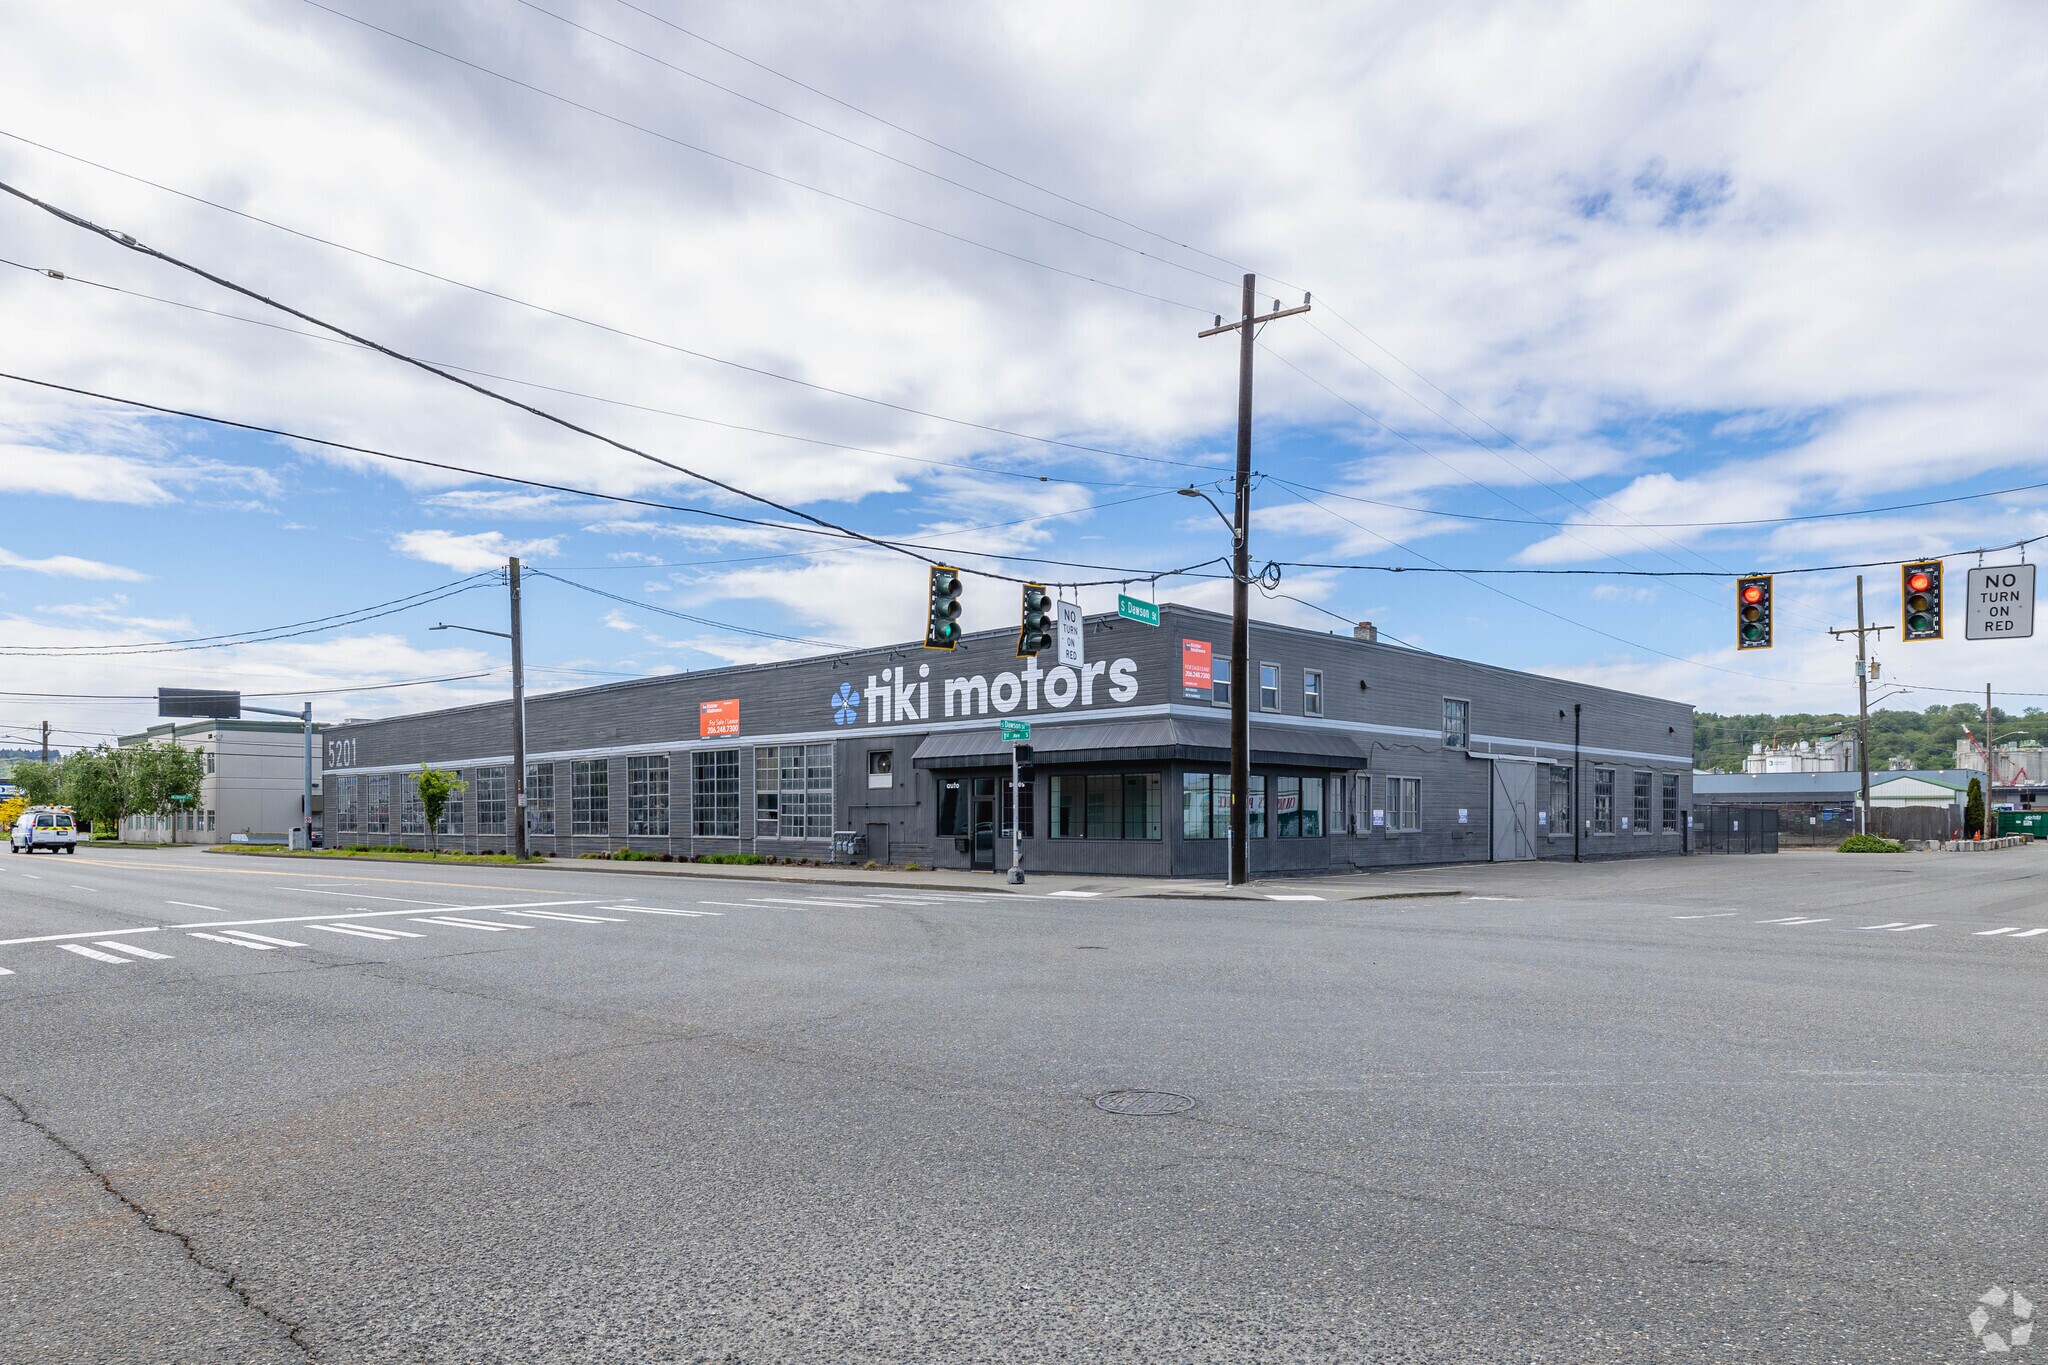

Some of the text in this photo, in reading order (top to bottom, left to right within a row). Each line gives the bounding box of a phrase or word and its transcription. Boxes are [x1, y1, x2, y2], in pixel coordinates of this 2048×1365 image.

[1986, 574, 2016, 588] NO
[1980, 591, 2020, 603] TURN
[1064, 609, 1076, 623] NO
[1120, 600, 1157, 621] S Dawson St
[1989, 606, 2009, 617] ON
[1063, 624, 1078, 635] TURN
[1985, 620, 2014, 631] RED
[1067, 637, 1076, 647] ON
[1065, 649, 1077, 661] RED
[864, 656, 1138, 724] tiki motors
[1005, 720, 1022, 730] Dawson
[328, 738, 356, 768] 5201
[946, 781, 960, 789] auto
